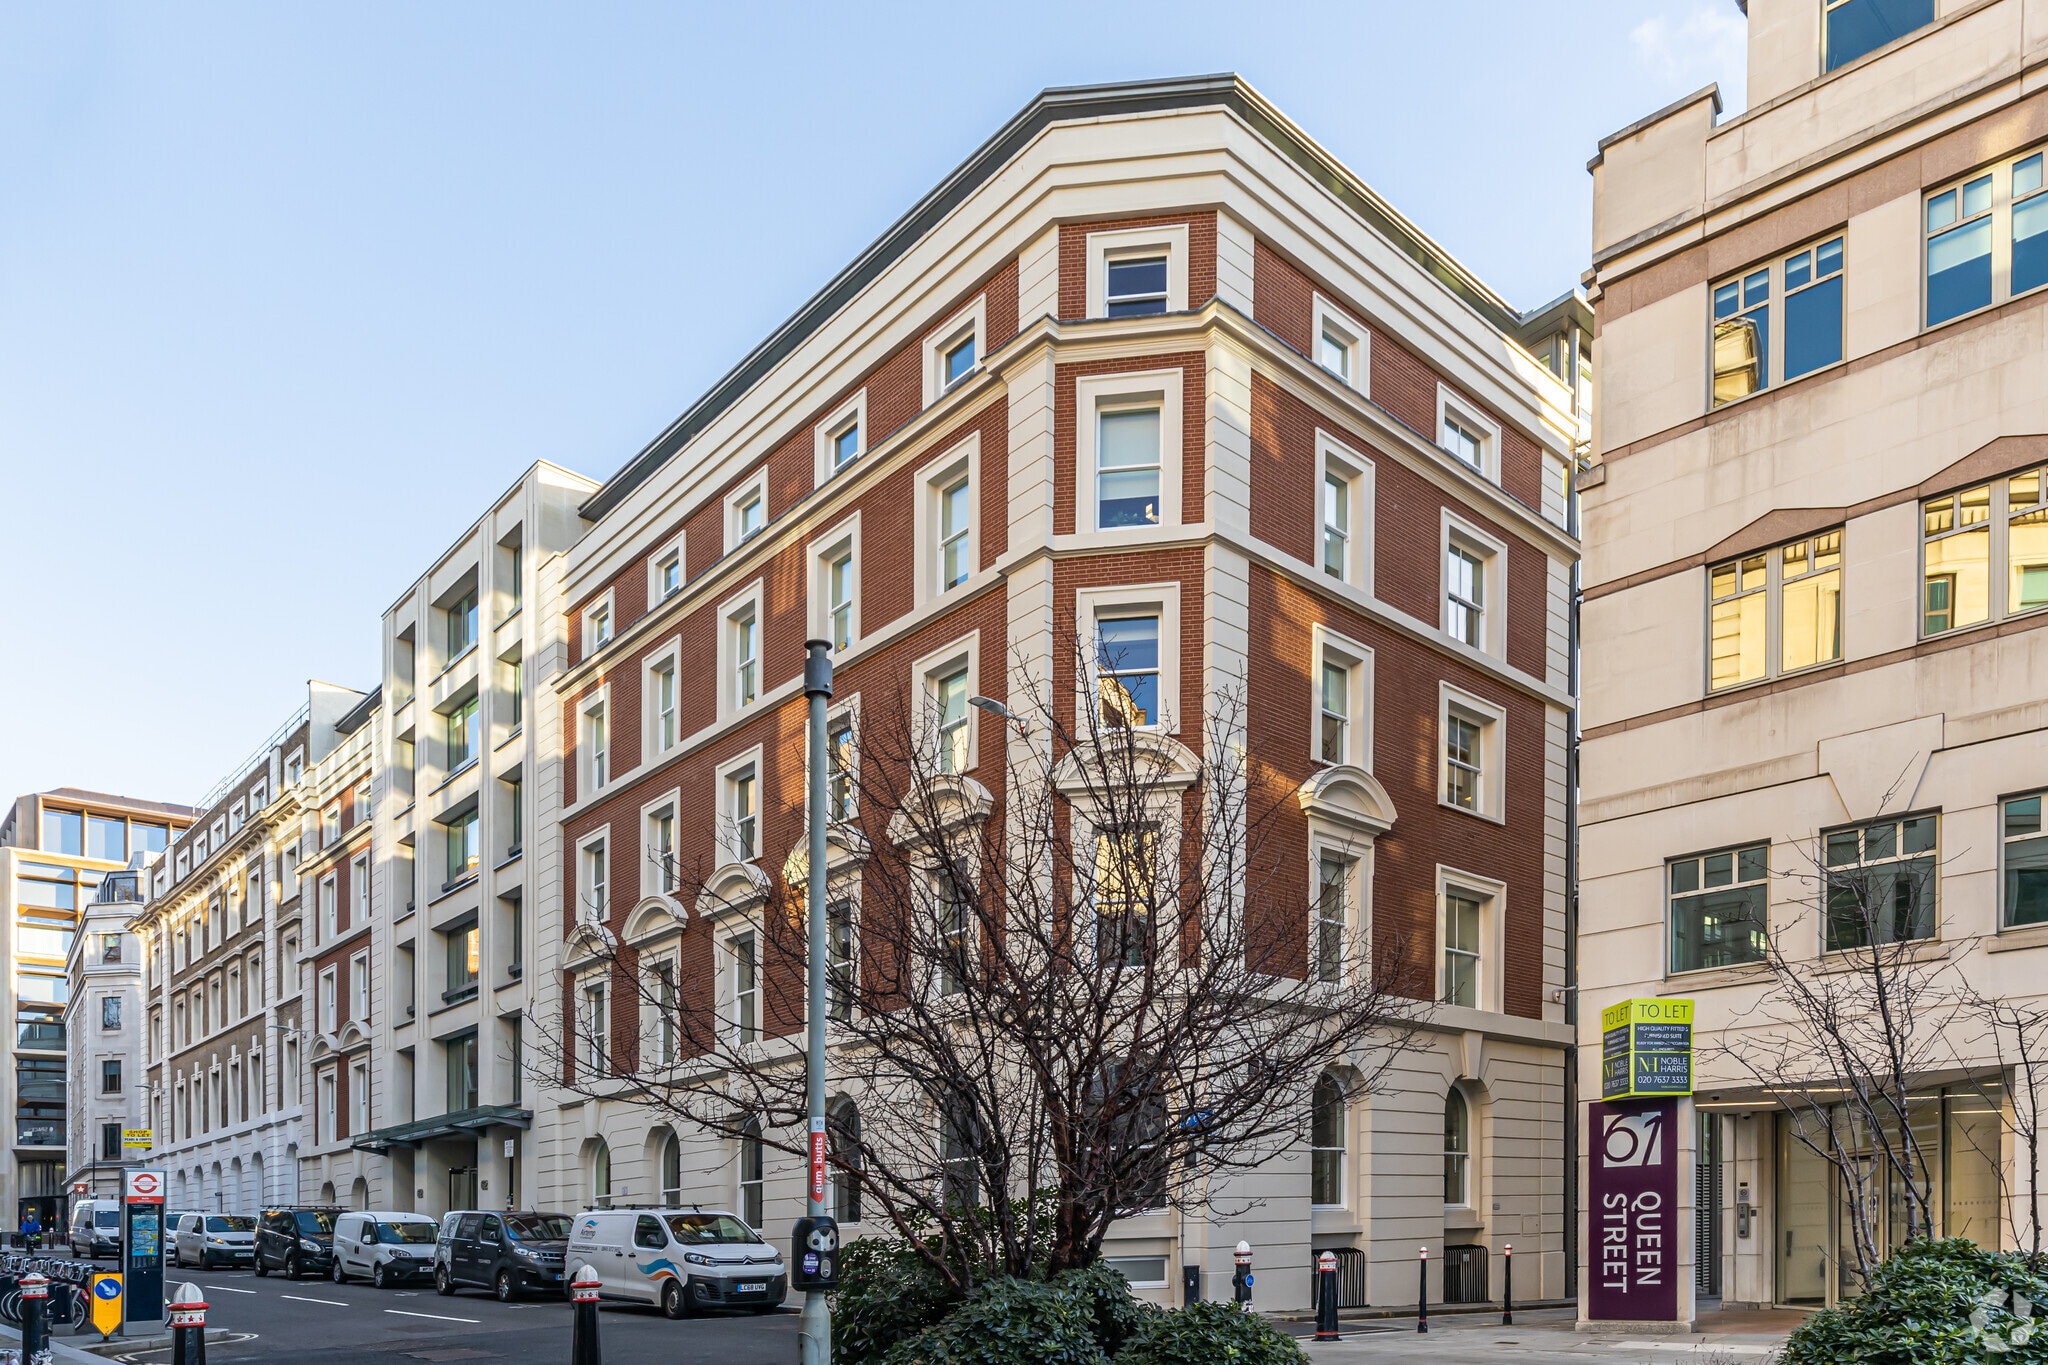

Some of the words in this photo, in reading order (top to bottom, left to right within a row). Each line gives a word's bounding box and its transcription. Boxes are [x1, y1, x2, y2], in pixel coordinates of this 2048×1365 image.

[1605, 1012, 1614, 1025] TO
[1616, 1006, 1629, 1022] LET
[1639, 1004, 1660, 1018] TO
[1664, 1005, 1688, 1018] LET
[1660, 1057, 1688, 1065] NOBLE
[1660, 1065, 1688, 1073] HARRIS
[1637, 1076, 1651, 1084] 020
[1653, 1076, 1670, 1084] 7637
[1671, 1076, 1688, 1084] 3333
[1603, 1112, 1662, 1167] 61
[814, 1137, 823, 1164] butts
[1603, 1193, 1627, 1293] STREET
[1631, 1191, 1661, 1285] QUEEN
